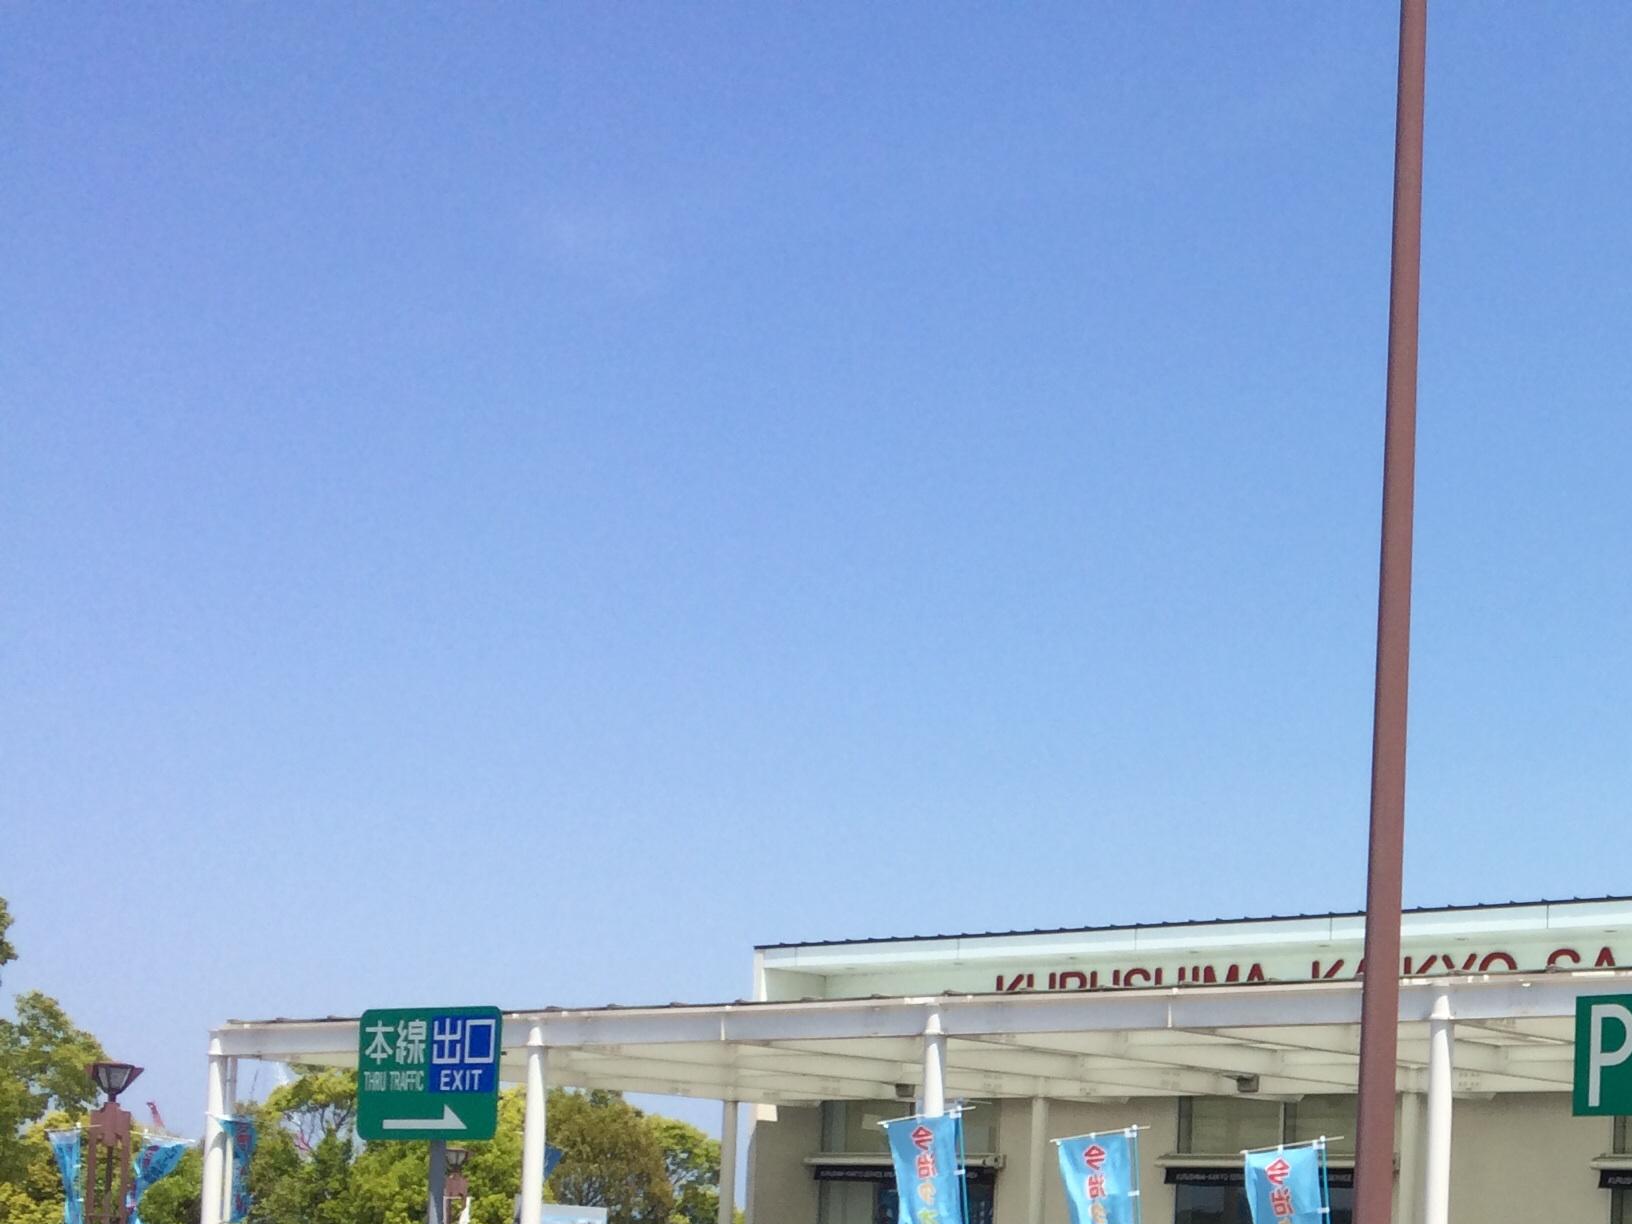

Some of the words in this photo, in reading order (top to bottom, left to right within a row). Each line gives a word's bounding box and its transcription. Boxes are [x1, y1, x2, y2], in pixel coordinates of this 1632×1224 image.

[365, 1019, 427, 1065] 本線
[432, 1018, 496, 1064] 出口
[364, 1071, 387, 1091] THRU
[440, 1069, 482, 1091] EXIT
